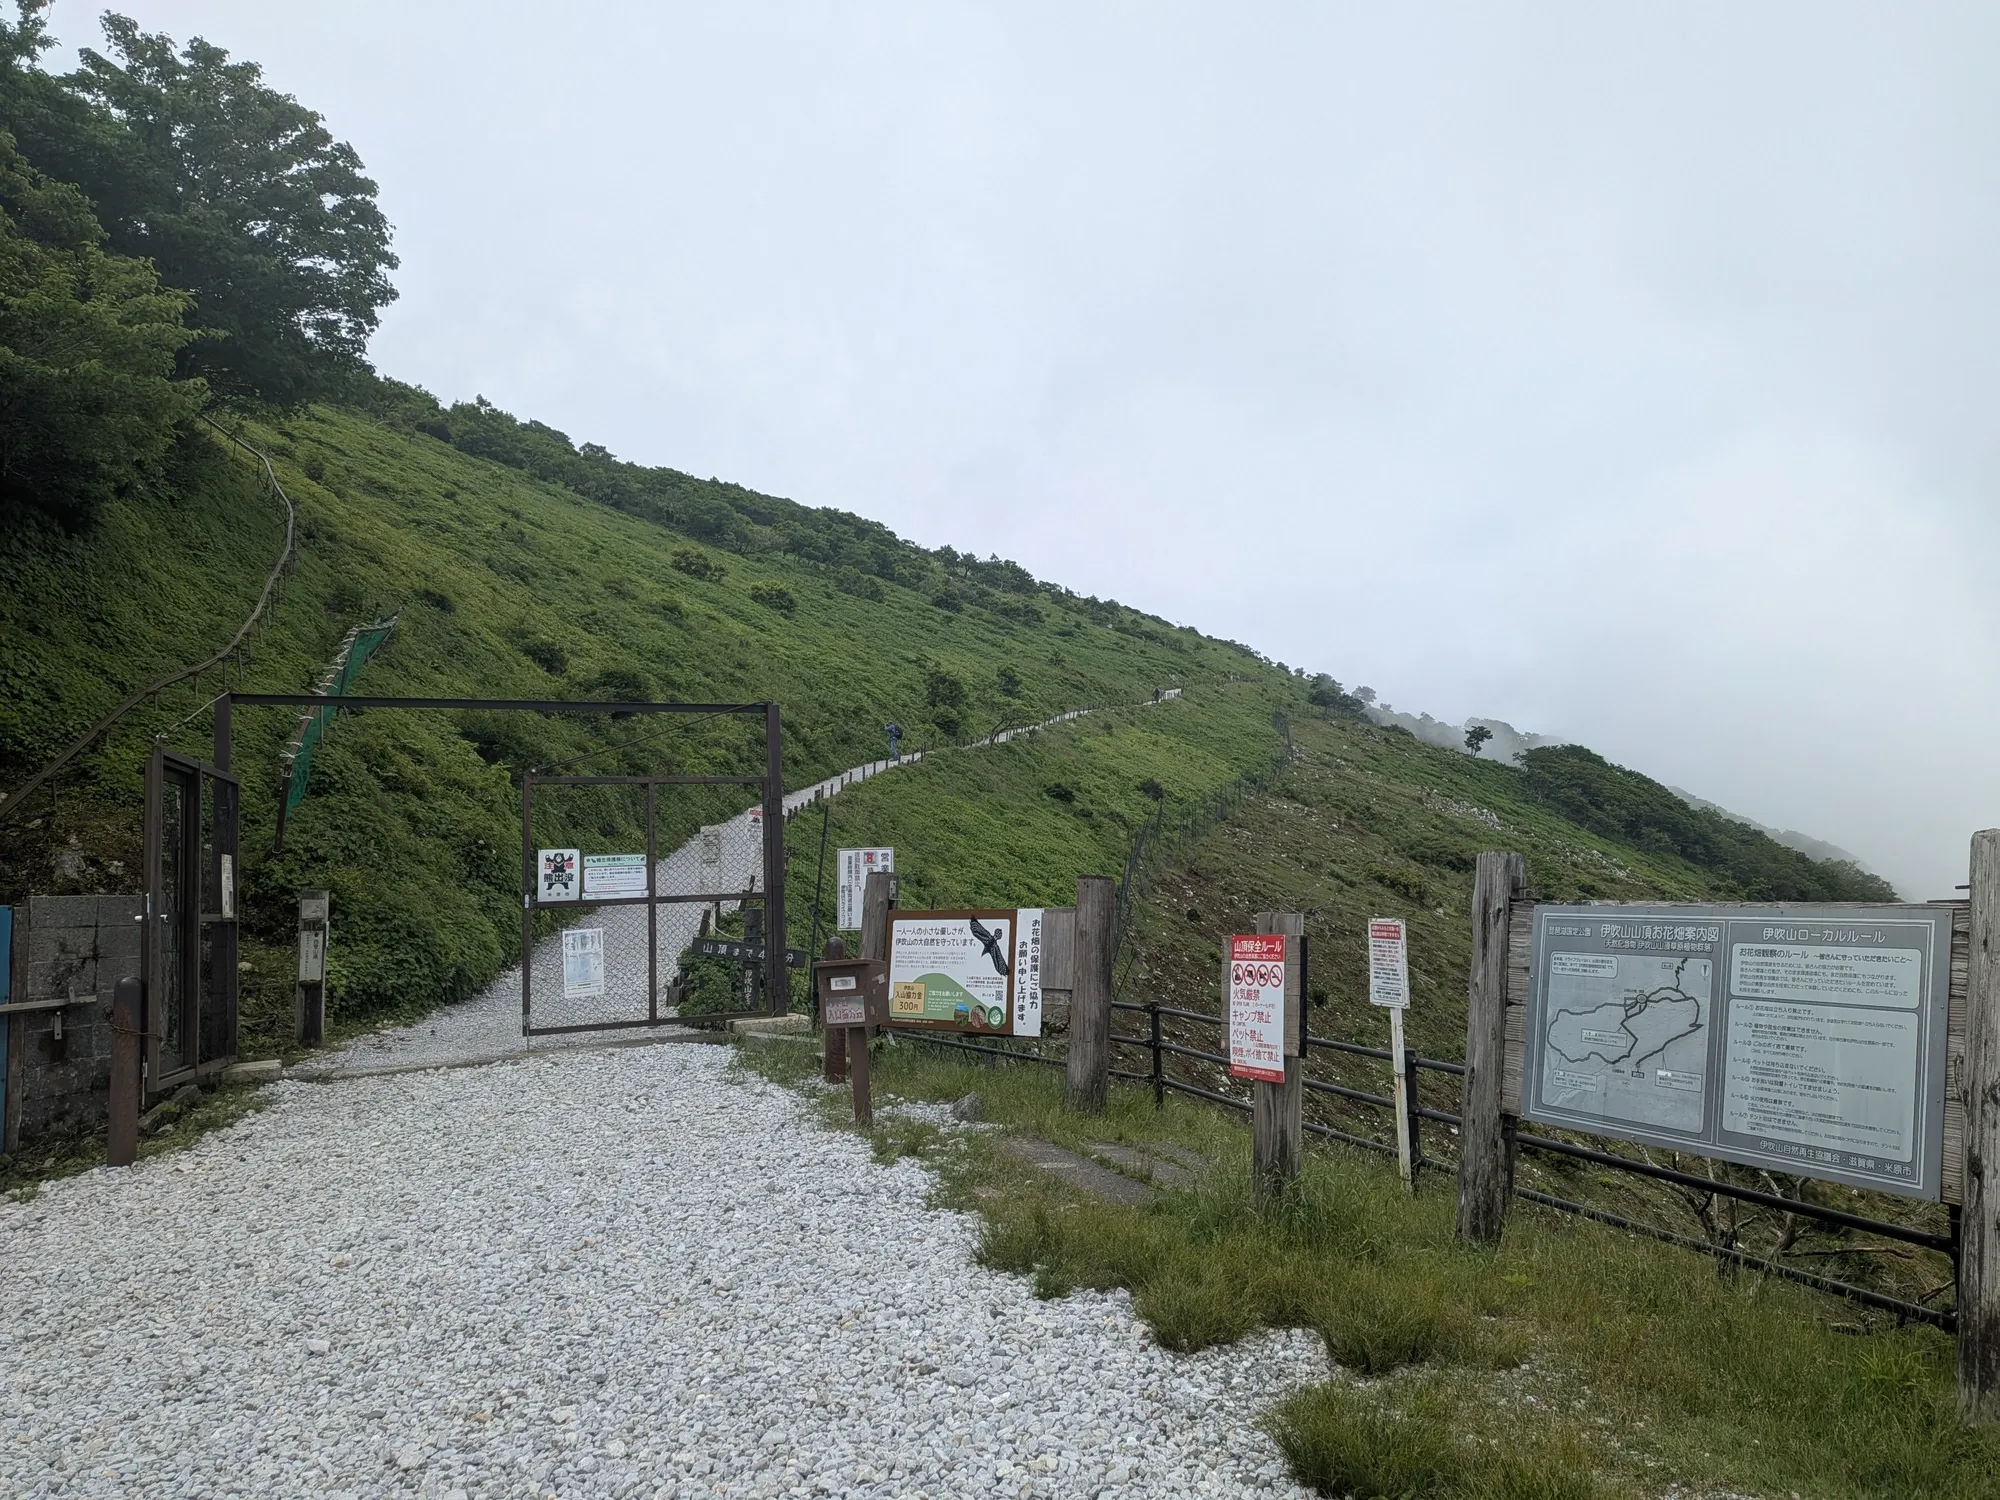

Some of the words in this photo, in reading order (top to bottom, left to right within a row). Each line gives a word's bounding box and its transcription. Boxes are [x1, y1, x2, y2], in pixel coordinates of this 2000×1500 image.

[544, 873, 574, 882] 熊出没
[896, 927, 966, 935] 一人一人の小さな優しさが、
[1600, 924, 1719, 942] 伊吹山山頂お花畑案内図
[1762, 927, 1886, 944] 伊吹山ローカルルール
[896, 938, 976, 947] 伊吹山の大自然を守っています。
[1234, 940, 1282, 952] 山頂保全ルール
[703, 942, 794, 962] 山頂まで4分
[1739, 948, 1809, 959] お花畑観察のルール
[1030, 919, 1040, 1010] お花畑の保護にご協力
[1017, 941, 1028, 1025] お願い申し上げます。
[895, 991, 922, 1000] 入山協力金
[1233, 988, 1260, 1001] 火気厳禁
[899, 1001, 918, 1010] 300円
[1232, 1010, 1271, 1024] キャンプ禁止
[1232, 1029, 1264, 1042] ペット禁止
